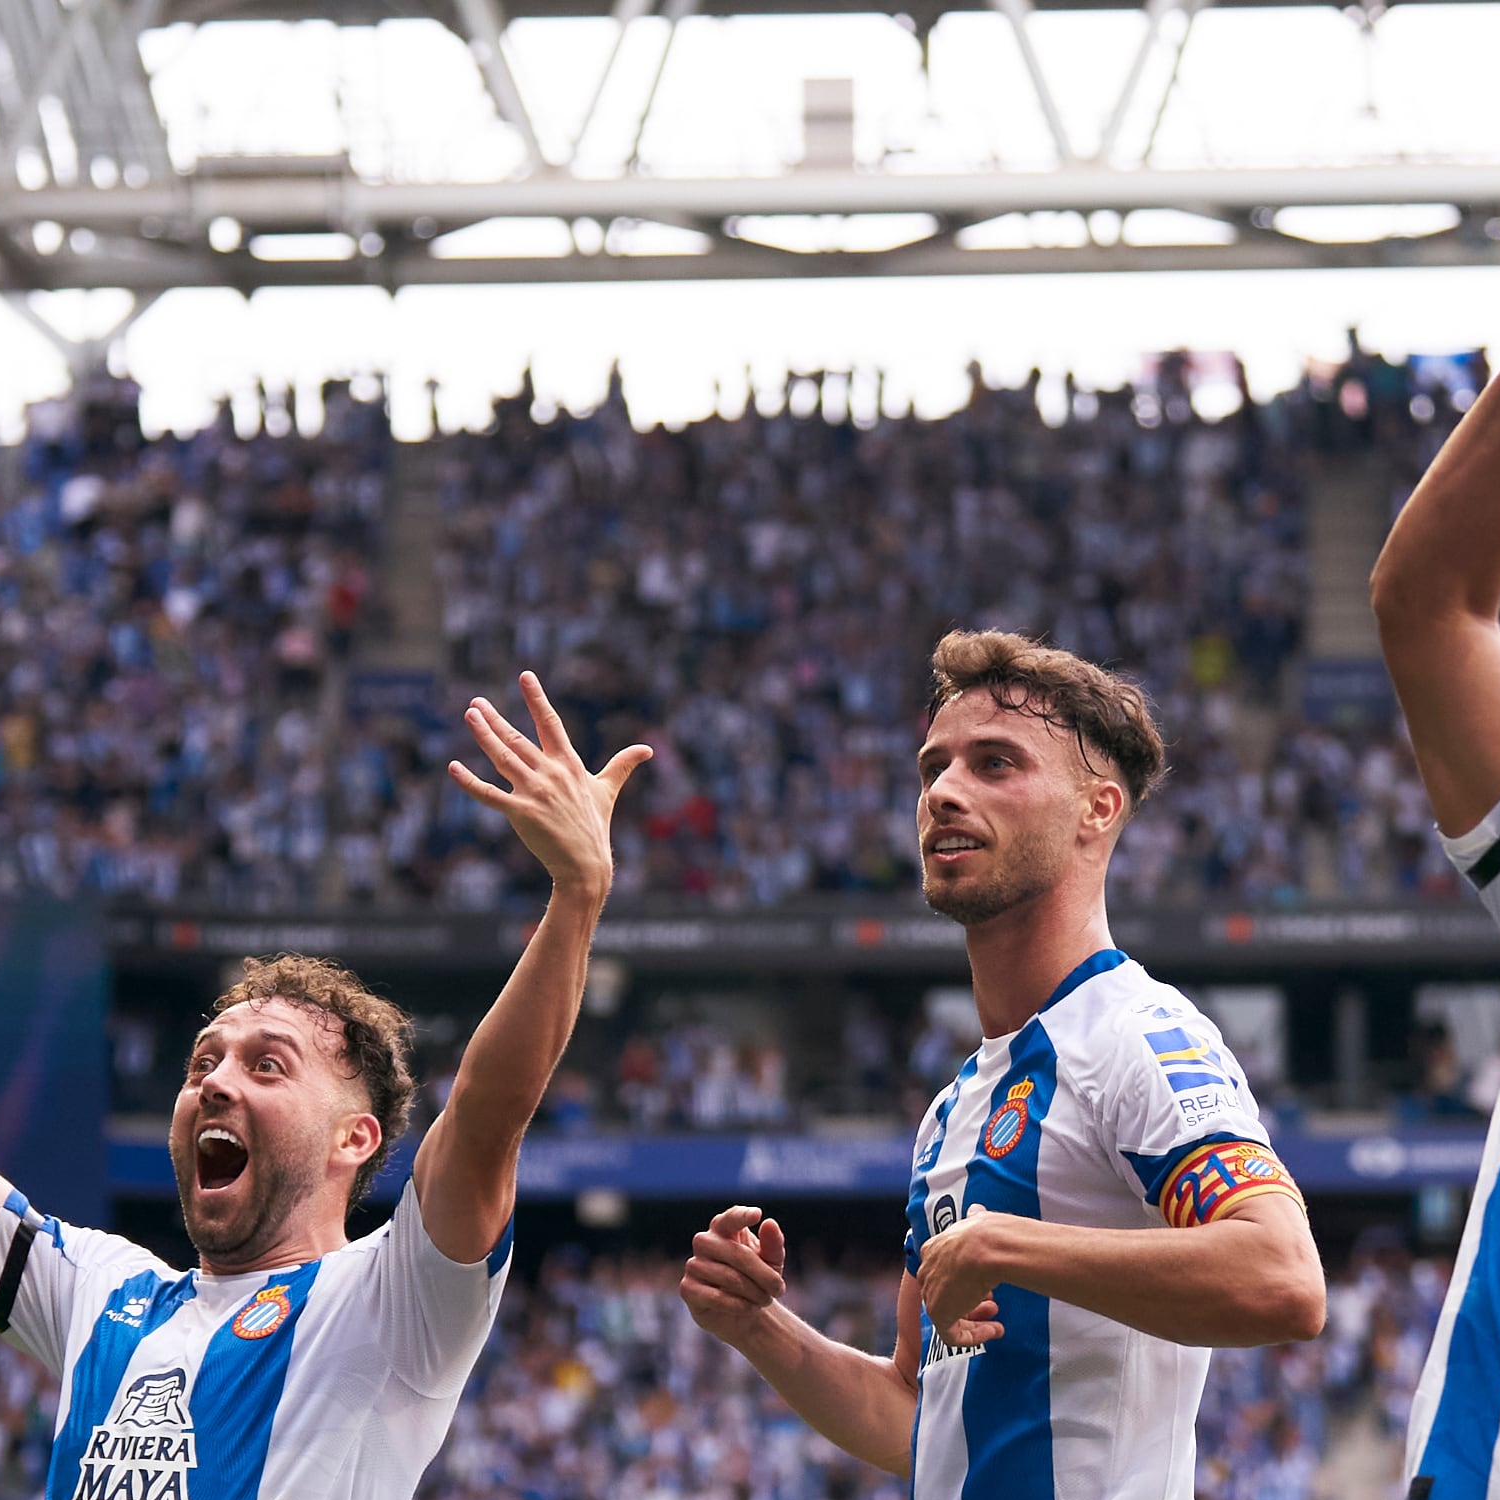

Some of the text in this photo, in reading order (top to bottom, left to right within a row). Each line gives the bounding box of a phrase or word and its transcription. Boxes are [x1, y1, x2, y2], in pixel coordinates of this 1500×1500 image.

[1179, 1092, 1241, 1114] REAL
[1175, 1152, 1238, 1223] 21
[89, 1430, 190, 1463] RIVIERA
